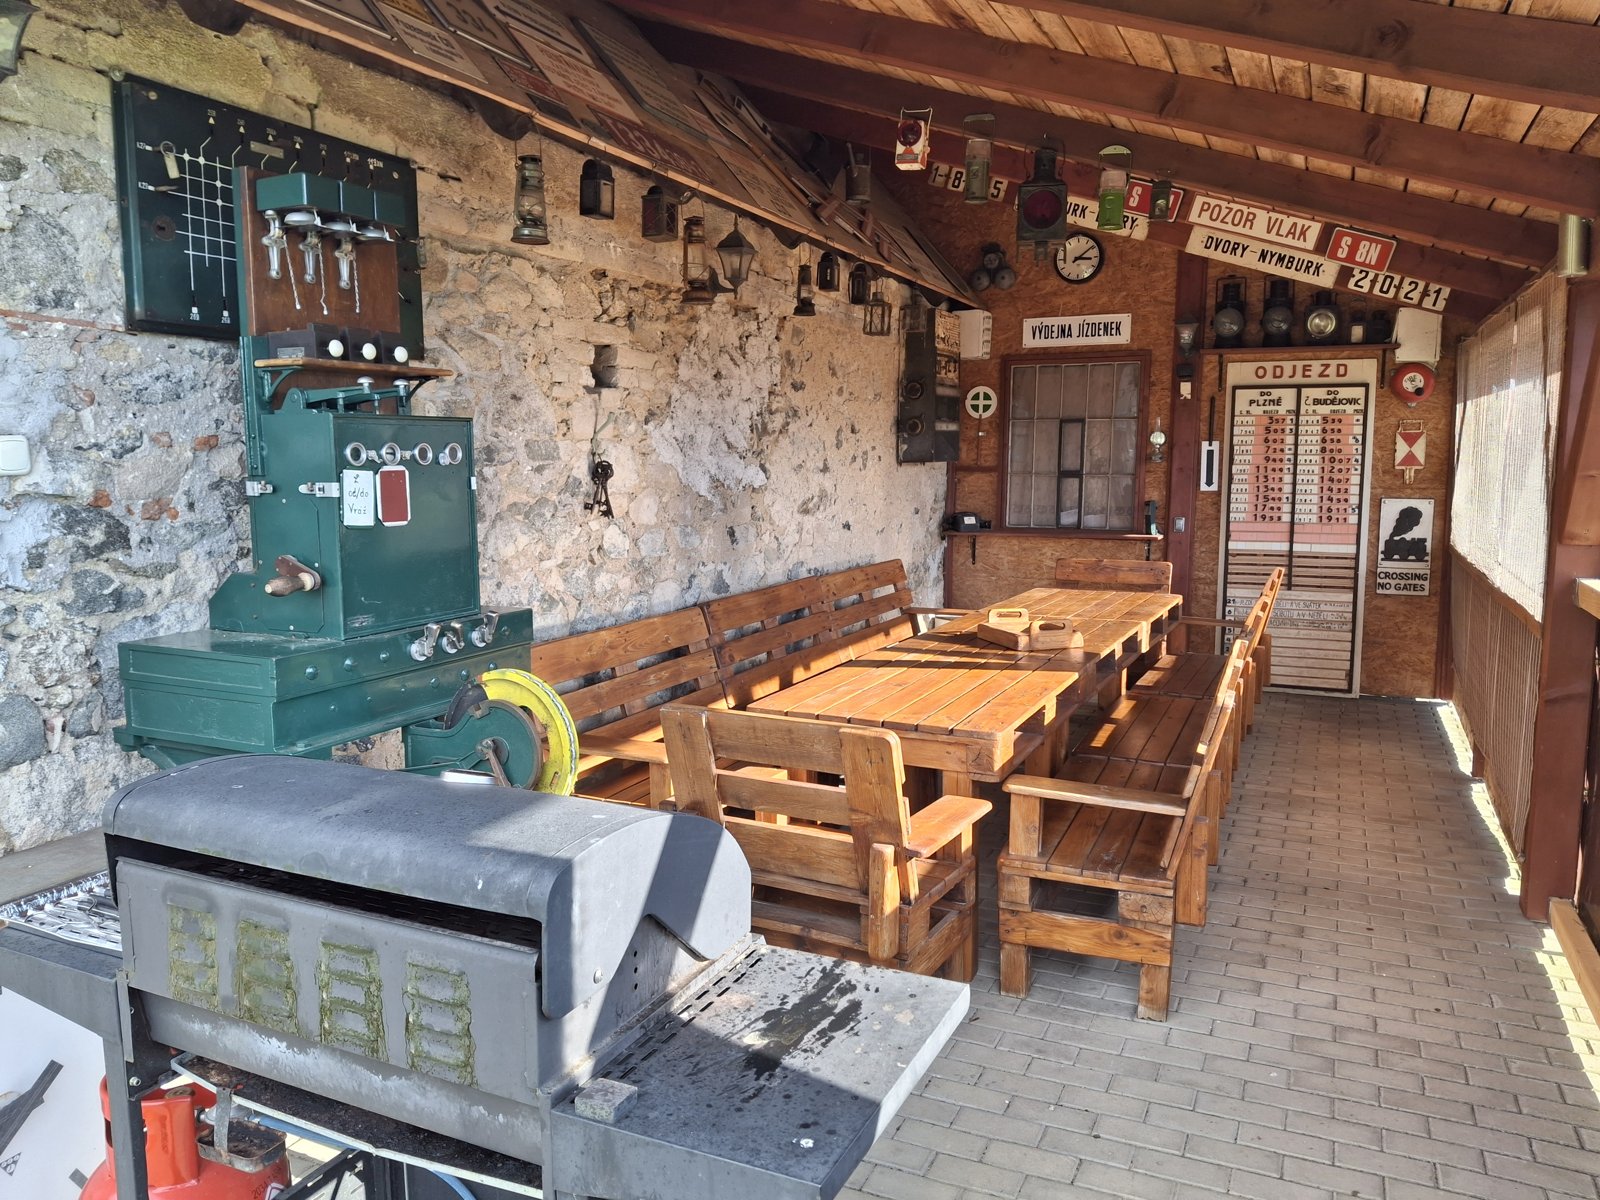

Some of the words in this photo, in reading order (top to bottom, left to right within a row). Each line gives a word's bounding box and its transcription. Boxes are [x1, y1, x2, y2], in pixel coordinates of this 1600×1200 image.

[1128, 186, 1143, 207] S
[1197, 201, 1256, 230] POZOR
[1265, 215, 1312, 242] VLAK
[1337, 236, 1352, 260] S
[1355, 240, 1381, 266] 8N
[1031, 322, 1073, 340] VÝDEJNA
[1076, 319, 1122, 338] JÍZDENEK
[1255, 363, 1348, 378] ODJEZD
[1249, 396, 1282, 407] PLZNĚ
[1318, 515, 1347, 523] 1911
[1378, 571, 1428, 581] CROSSING
[1377, 582, 1391, 590] NO
[1394, 583, 1426, 592] GATES
